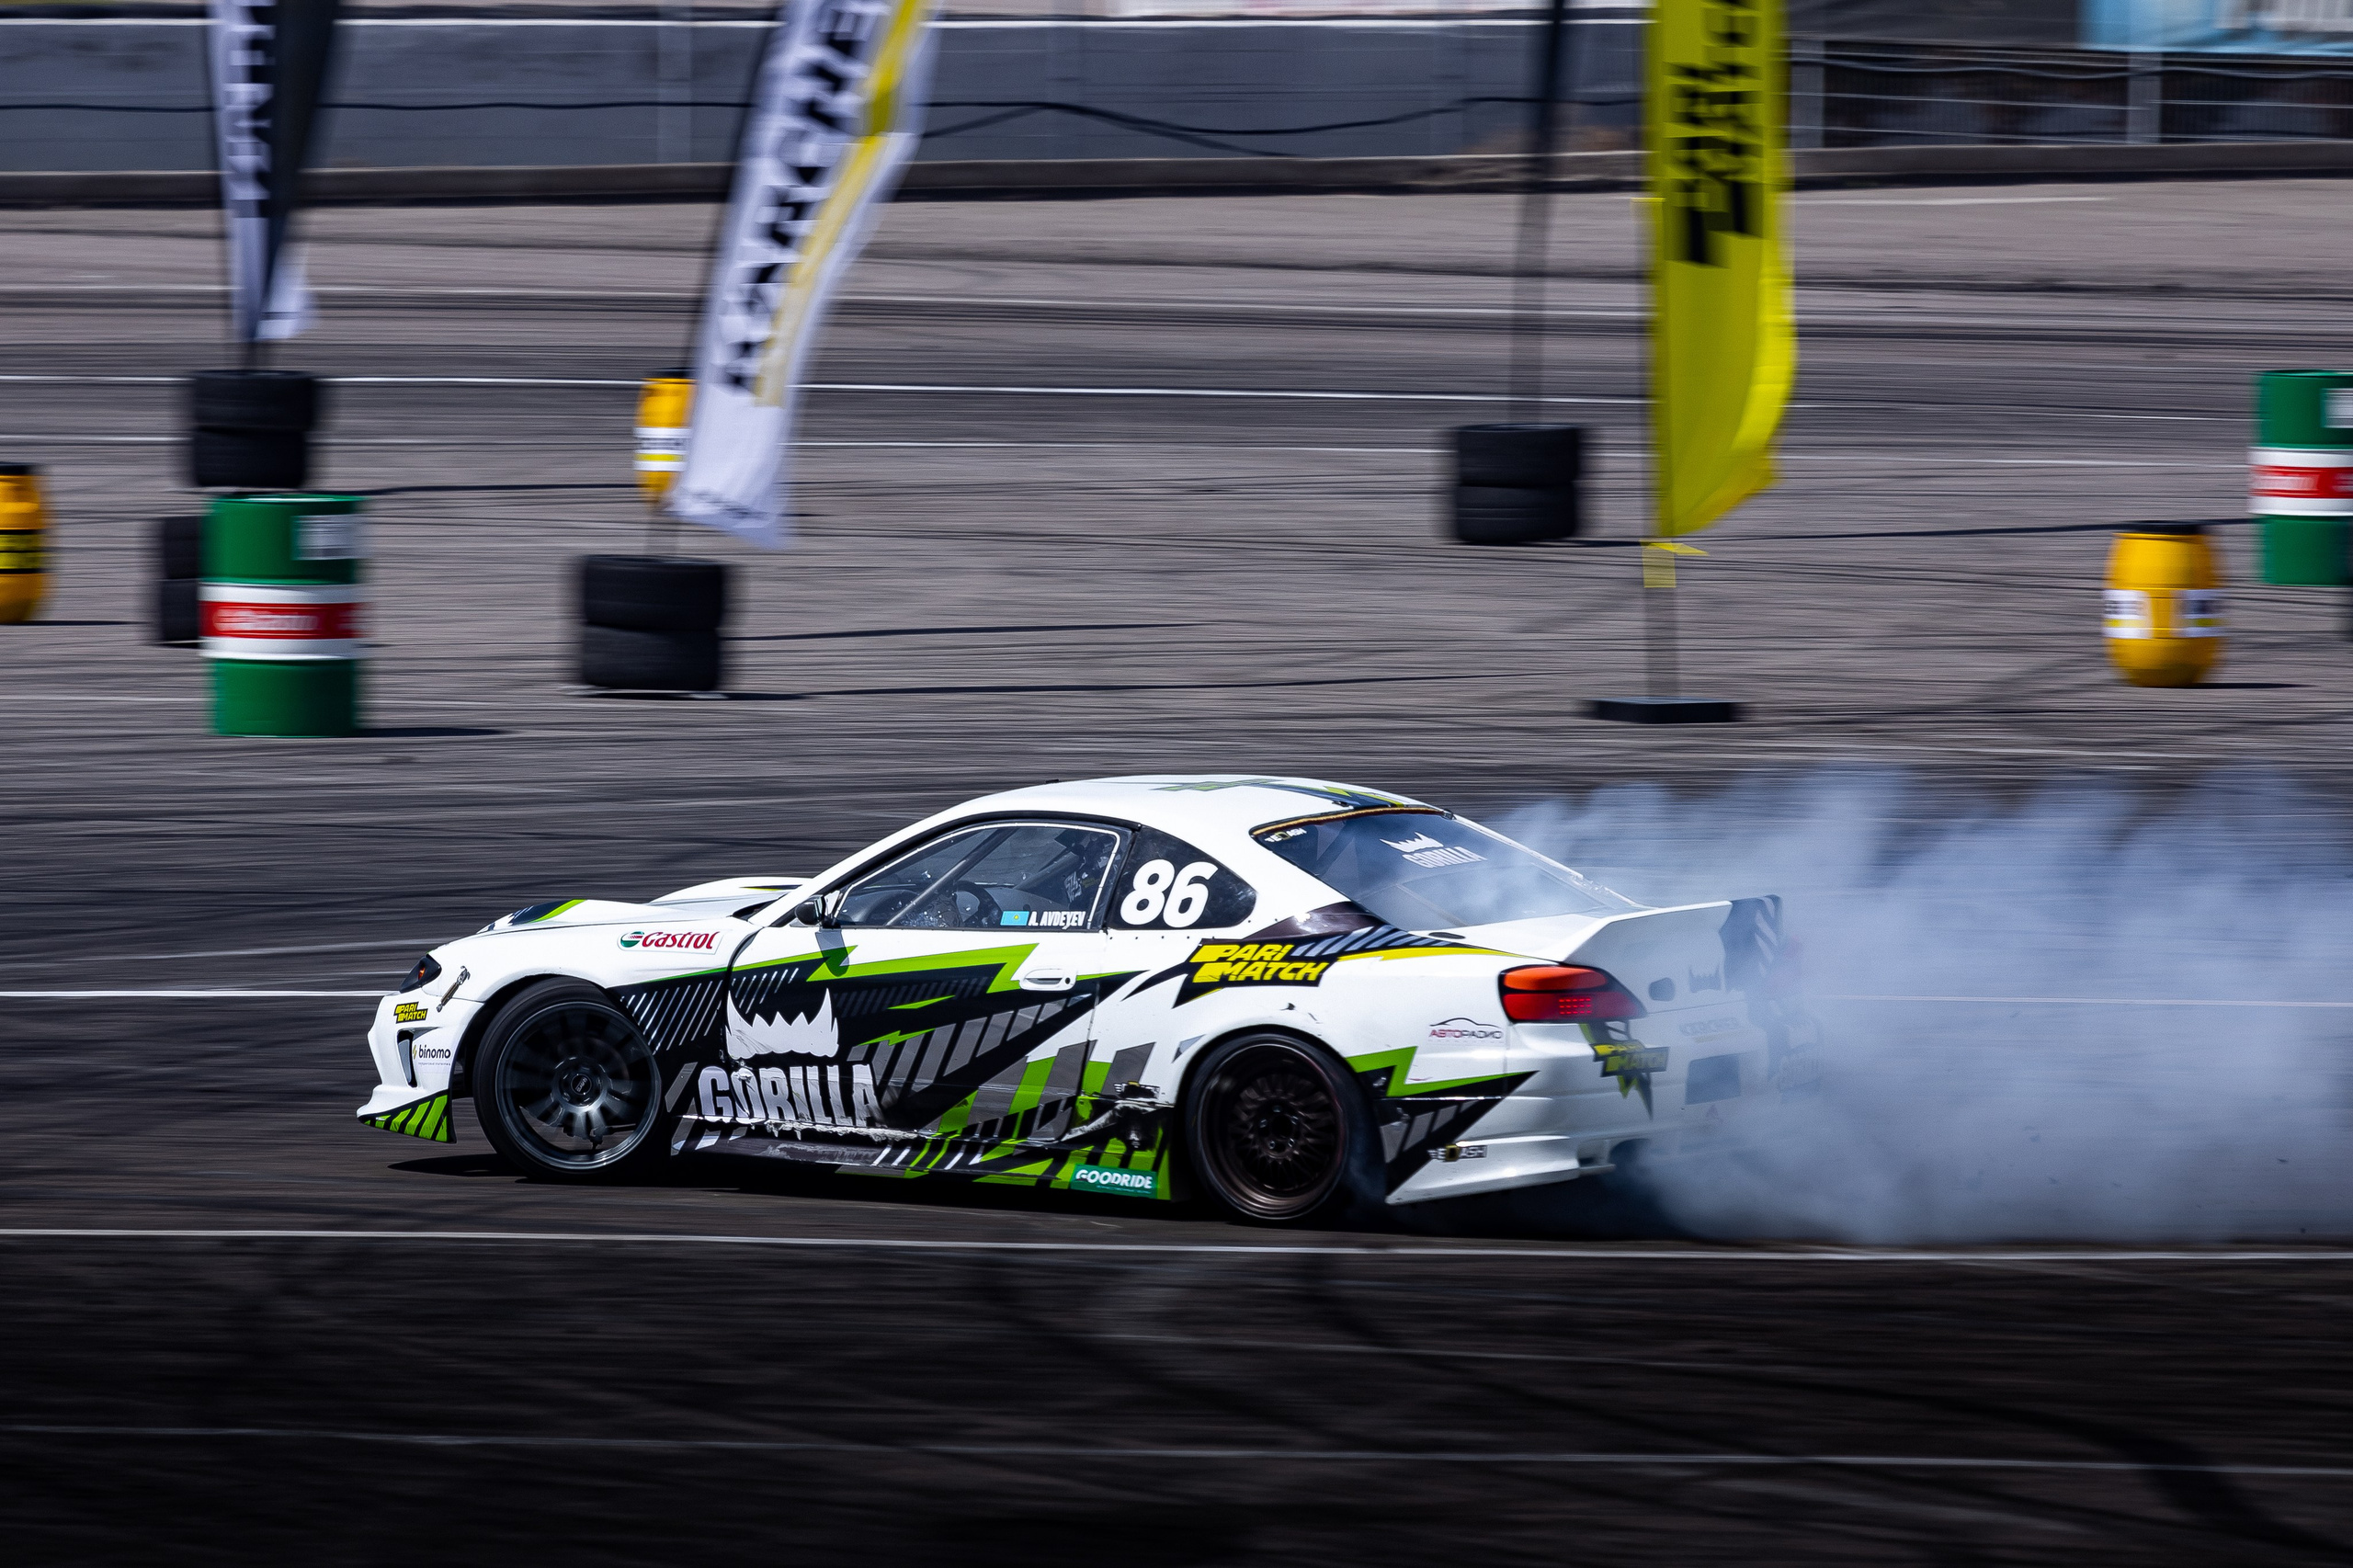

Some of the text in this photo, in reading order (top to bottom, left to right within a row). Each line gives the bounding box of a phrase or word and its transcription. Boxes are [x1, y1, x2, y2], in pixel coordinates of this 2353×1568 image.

[1120, 858, 1219, 928] 86
[1040, 911, 1086, 930] AVDEYEV
[642, 931, 721, 949] Castrol
[1189, 944, 1294, 962] PARI
[1192, 961, 1330, 983] MATCH
[395, 1003, 417, 1014] PARI
[398, 1010, 427, 1022] MATCH
[418, 1044, 451, 1059] binomo
[698, 1063, 888, 1129] GORILLA
[1075, 1169, 1153, 1189] GOODRIDE
